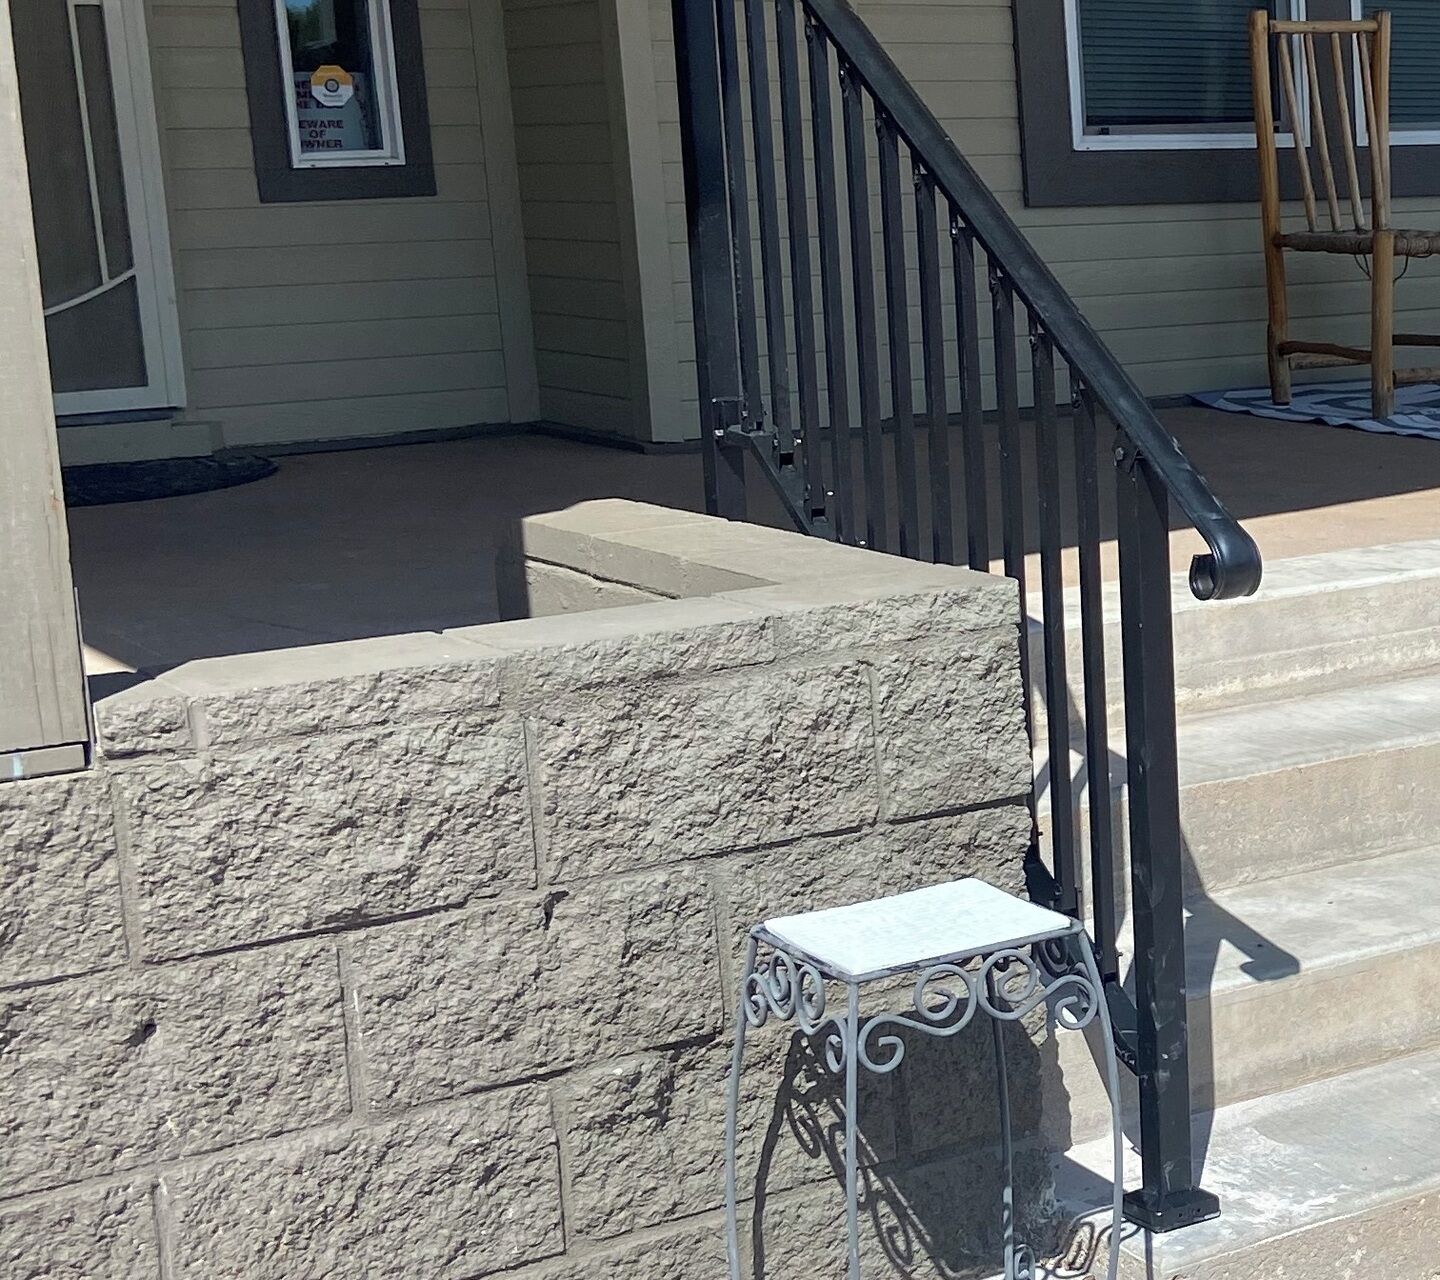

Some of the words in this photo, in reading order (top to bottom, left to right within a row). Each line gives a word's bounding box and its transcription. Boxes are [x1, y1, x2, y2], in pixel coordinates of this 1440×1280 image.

[299, 120, 344, 129] EWARE
[310, 130, 326, 138] OF
[301, 140, 343, 148] WNER
